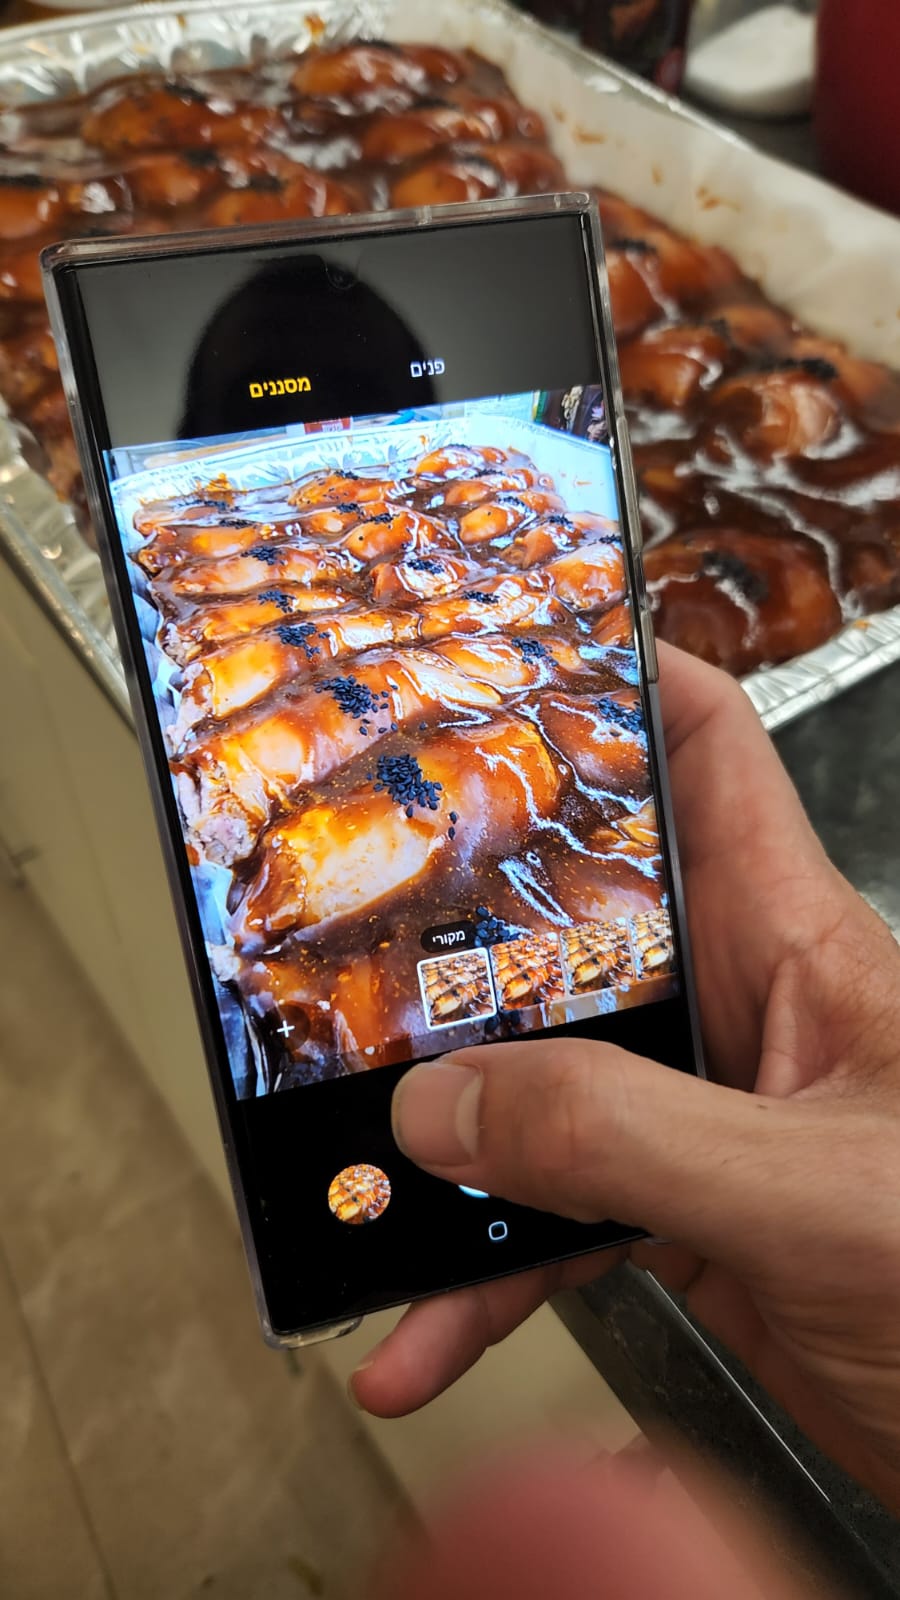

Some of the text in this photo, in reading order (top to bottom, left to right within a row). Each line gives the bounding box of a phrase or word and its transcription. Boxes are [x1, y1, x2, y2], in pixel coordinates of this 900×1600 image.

[410, 358, 445, 378] פנים
[249, 376, 311, 398] מסננים
[432, 930, 466, 946] מקורי
